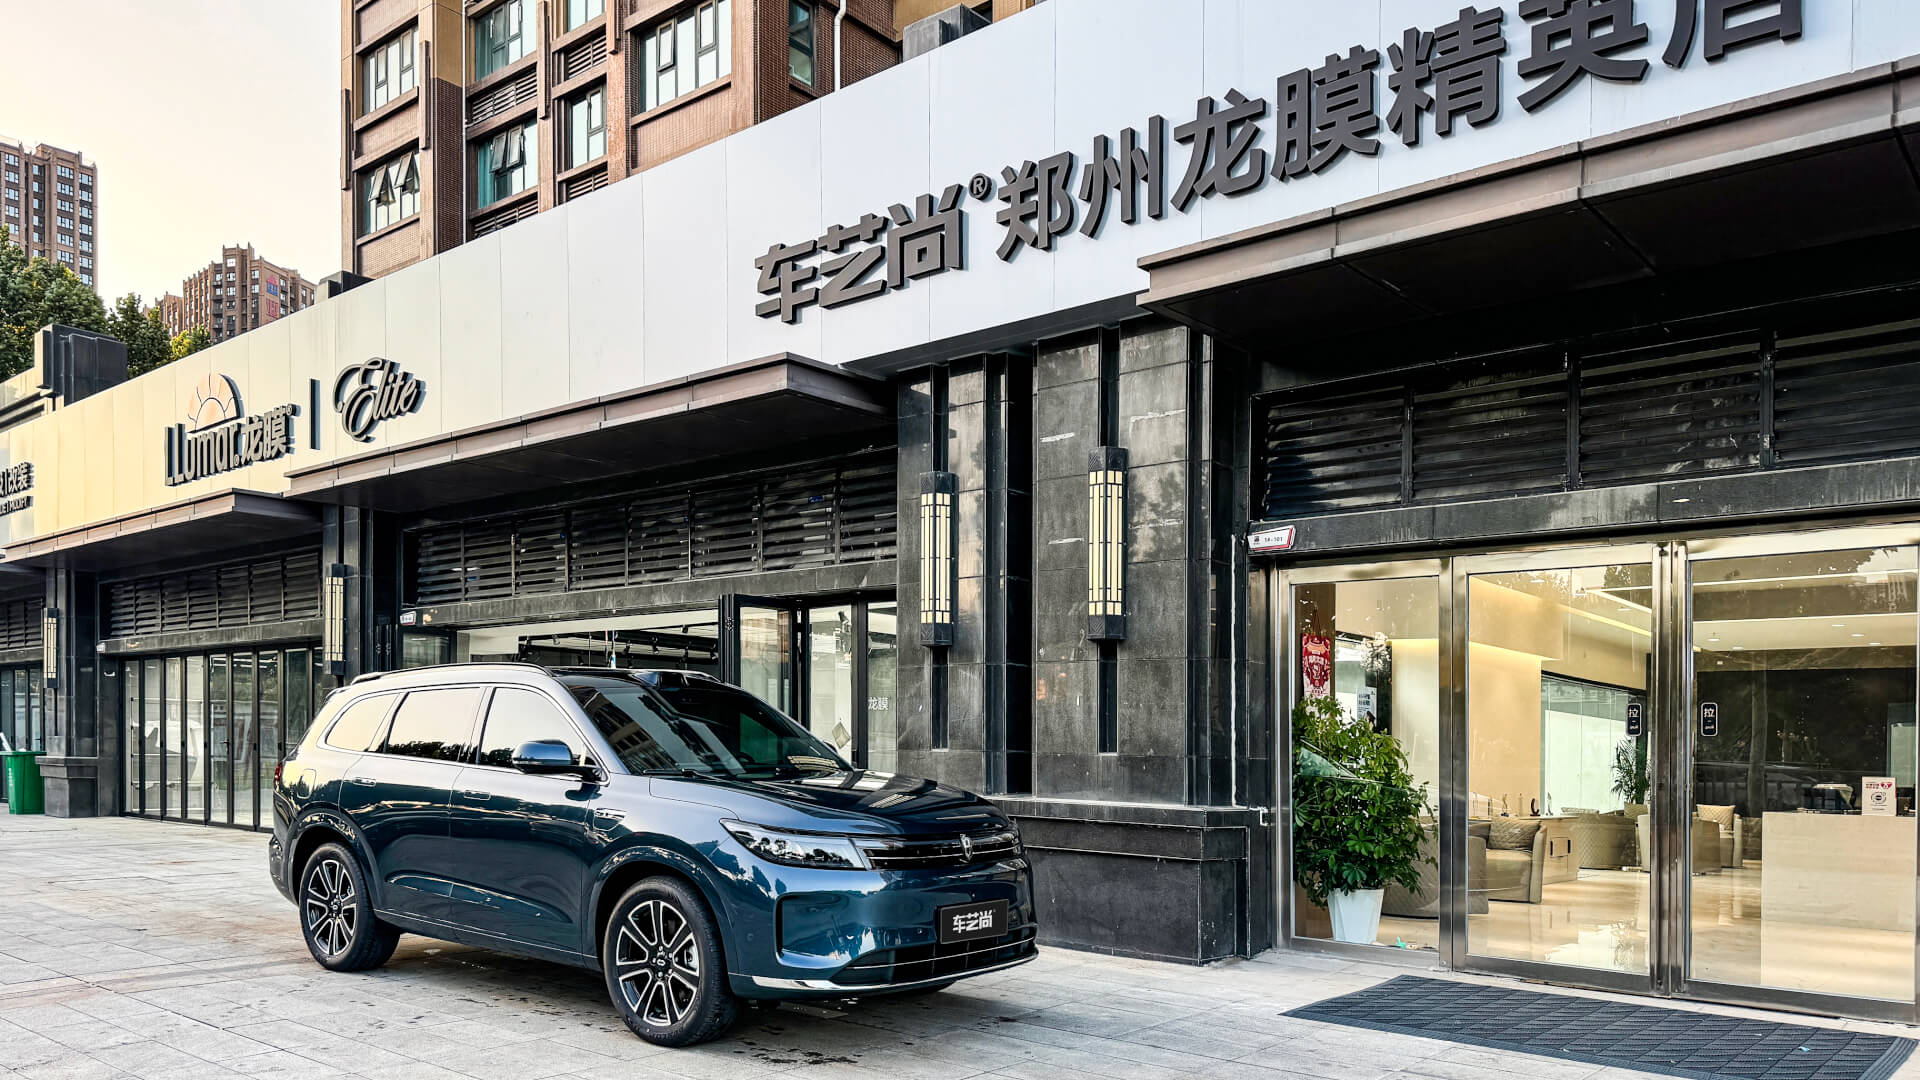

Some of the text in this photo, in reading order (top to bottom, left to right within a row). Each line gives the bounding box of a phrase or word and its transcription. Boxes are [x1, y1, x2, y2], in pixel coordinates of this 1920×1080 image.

[333, 357, 421, 442] Elite
[1628, 708, 1639, 718] 拉
[1703, 708, 1715, 718] 拉
